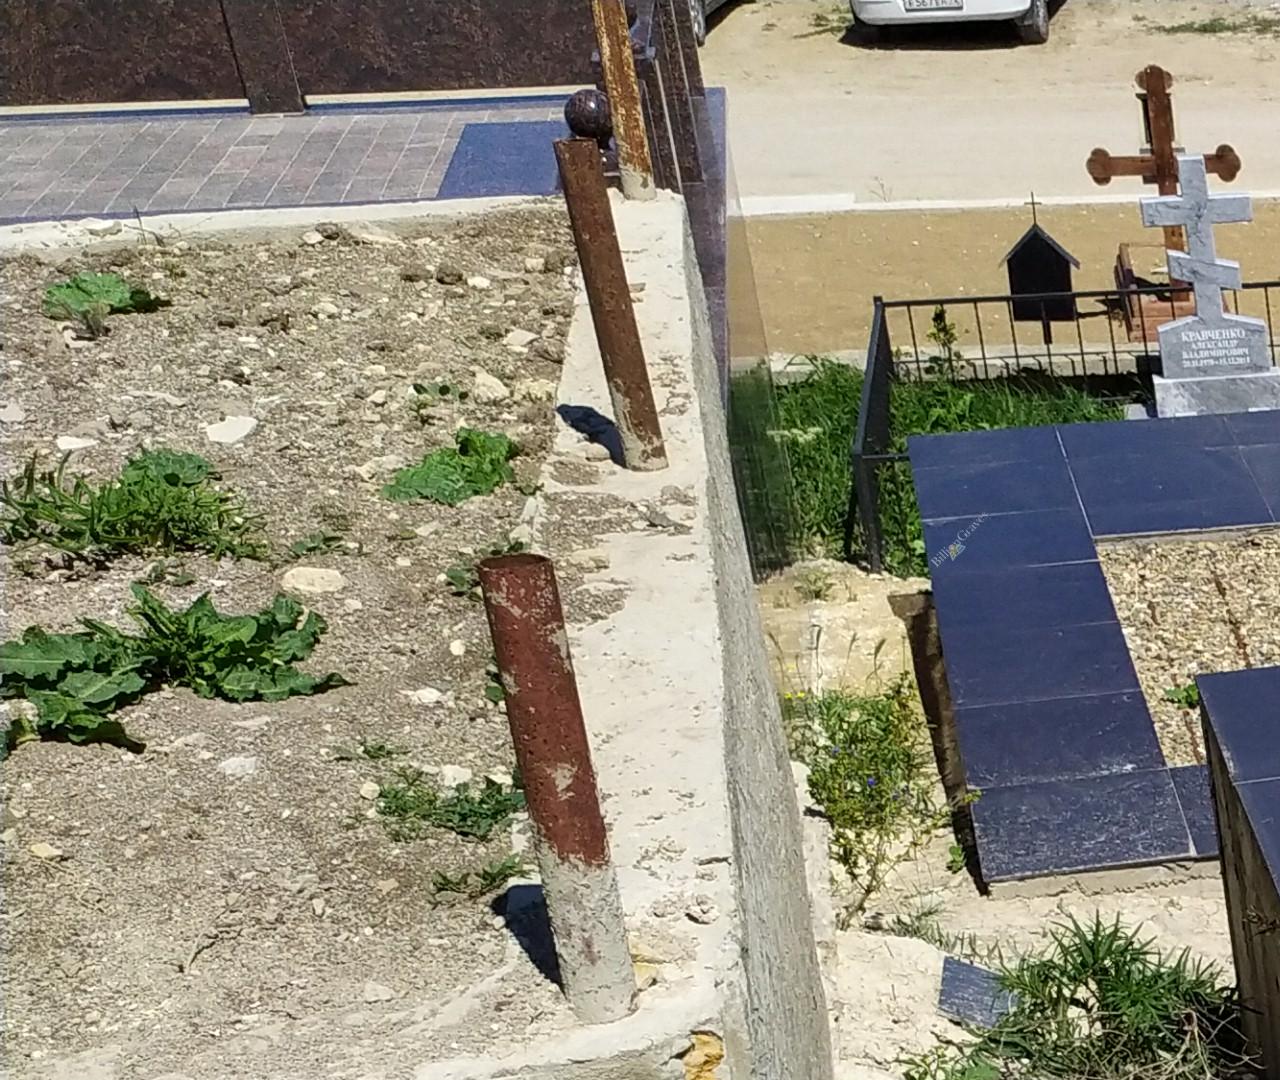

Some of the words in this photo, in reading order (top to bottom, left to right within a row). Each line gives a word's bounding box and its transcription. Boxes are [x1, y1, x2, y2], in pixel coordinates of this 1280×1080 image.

[1181, 328, 1246, 342] КРАВЧЕНКО
[1191, 340, 1239, 350] АЛЕКСАНДР
[1182, 347, 1249, 360] ВЛАДИМИРОВИЧ
